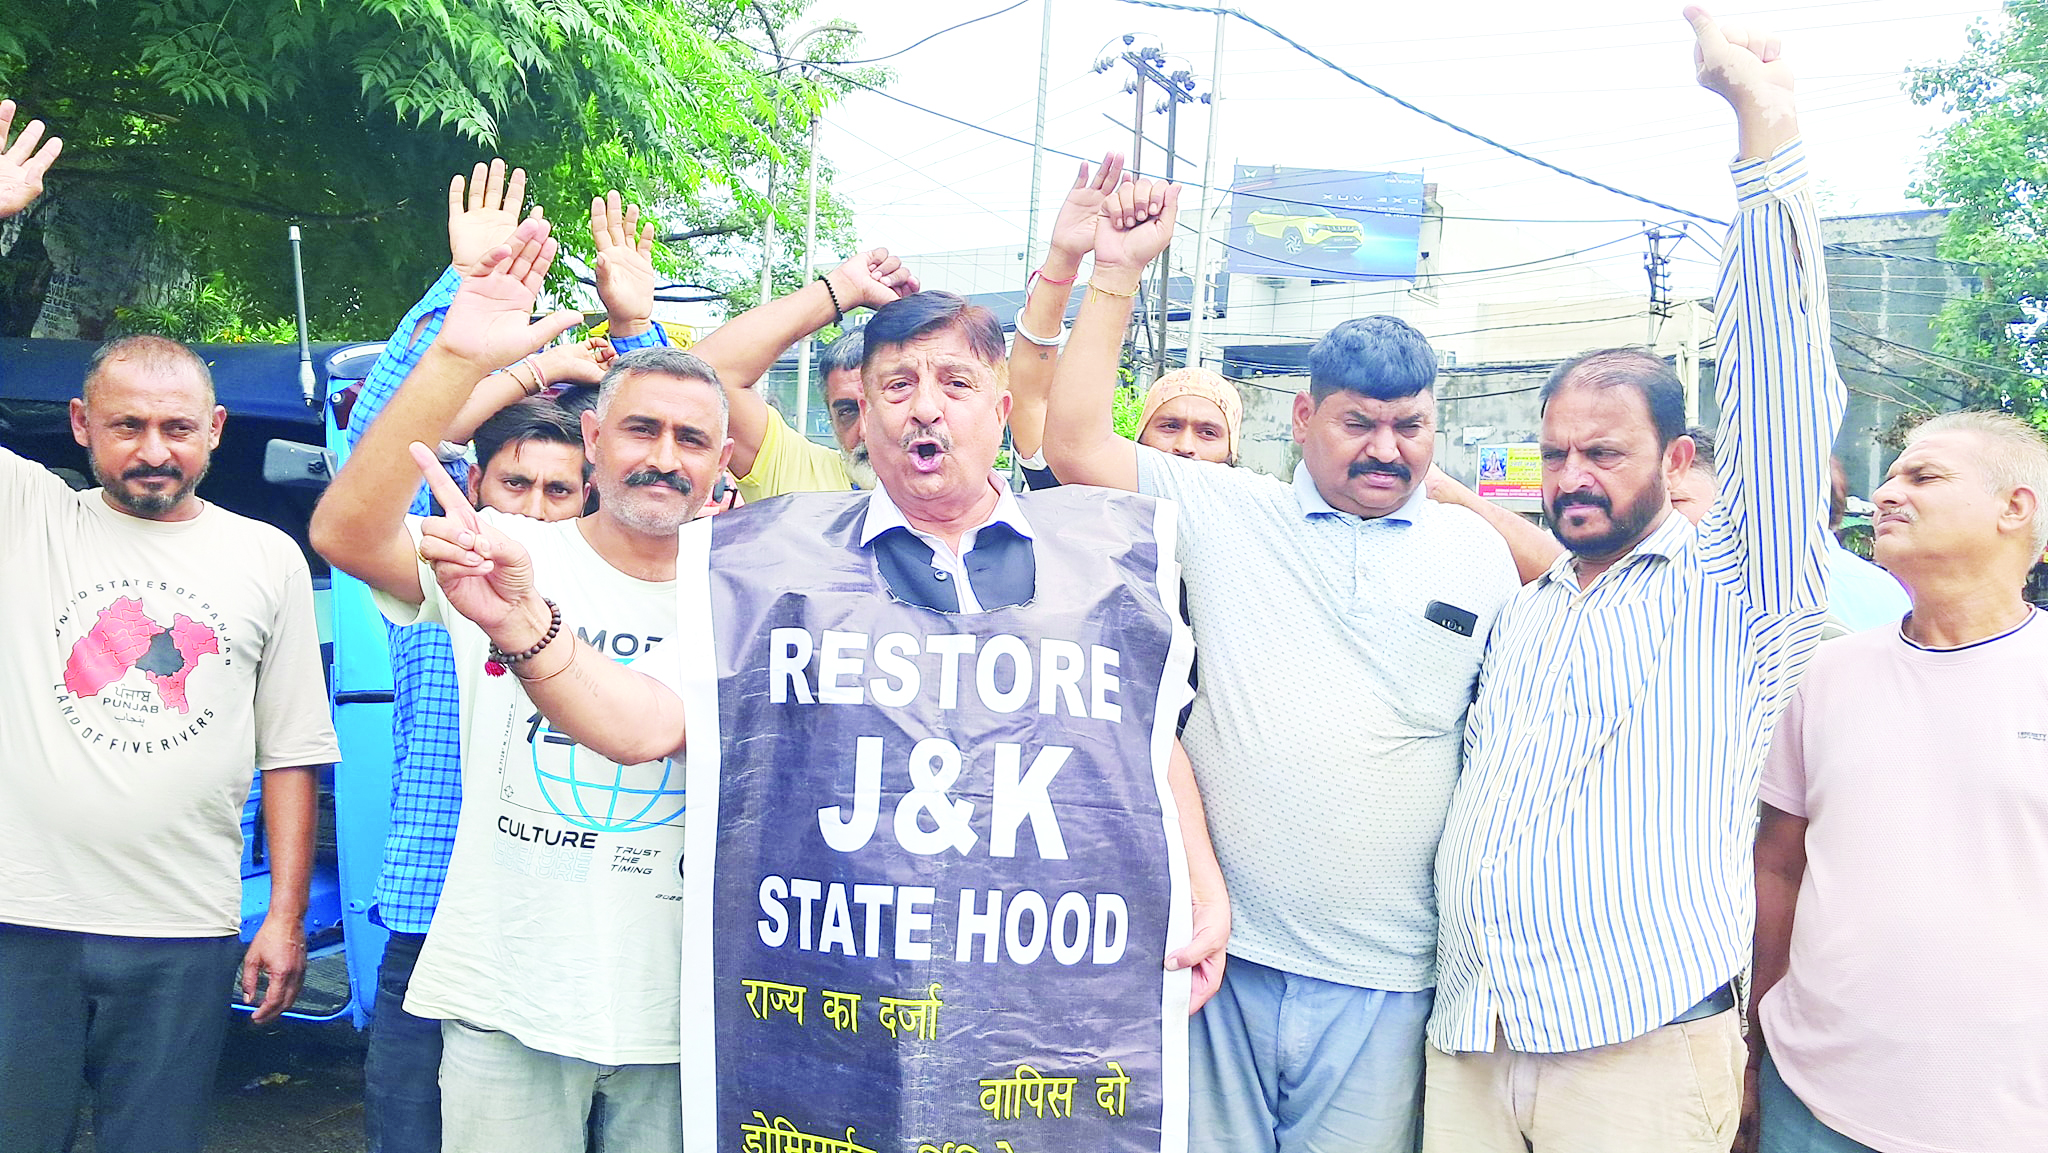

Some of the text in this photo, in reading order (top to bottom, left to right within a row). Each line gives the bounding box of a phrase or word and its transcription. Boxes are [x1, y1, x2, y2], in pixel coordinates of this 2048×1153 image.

[1323, 193, 1363, 202] XUV
[96, 579, 167, 592] STATES
[175, 587, 197, 600] OF
[769, 627, 1122, 724] RESTORE
[54, 684, 214, 754] LAND OF FIVE RIVERS
[102, 697, 159, 714] PUNJAB
[817, 735, 1075, 861] J&K
[497, 815, 599, 849] CULTURE
[612, 855, 640, 865] THE
[615, 846, 662, 858] TRUST
[610, 864, 654, 876] TIMING
[757, 875, 1129, 966] STATE HOOD
[741, 979, 943, 1041] राज्य का दर्जा
[979, 1060, 1131, 1120] वापिस दो
